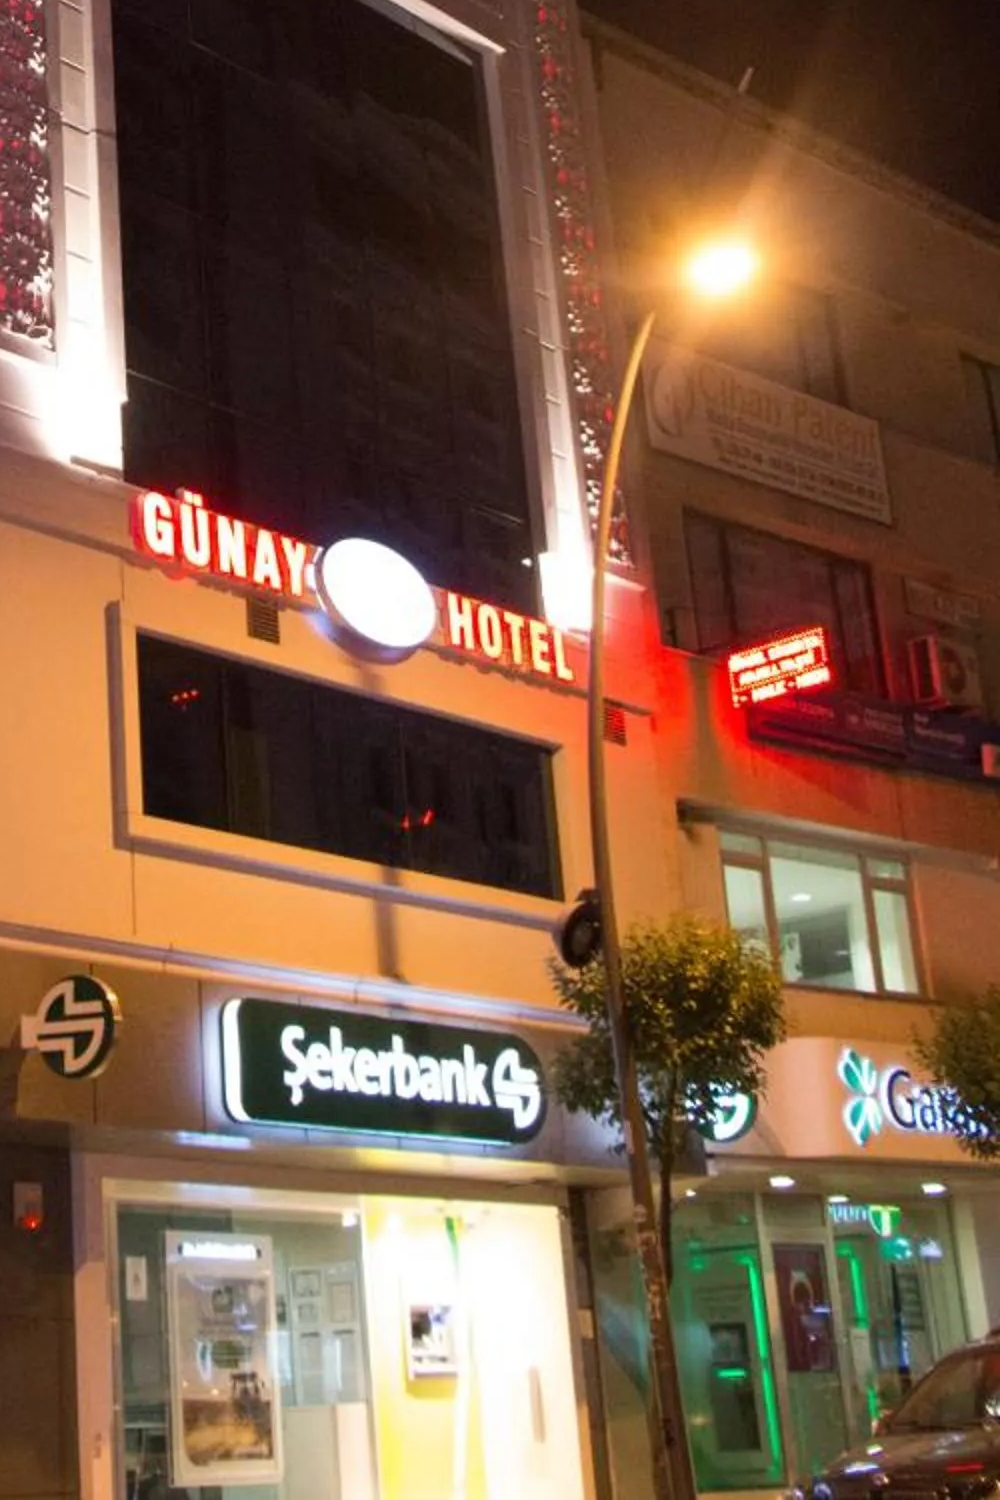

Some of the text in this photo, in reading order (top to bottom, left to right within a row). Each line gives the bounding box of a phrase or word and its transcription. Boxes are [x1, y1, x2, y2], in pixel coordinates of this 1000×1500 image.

[140, 489, 575, 681] GÜNAY HOTEL
[279, 1023, 493, 1107] Şekerbank
